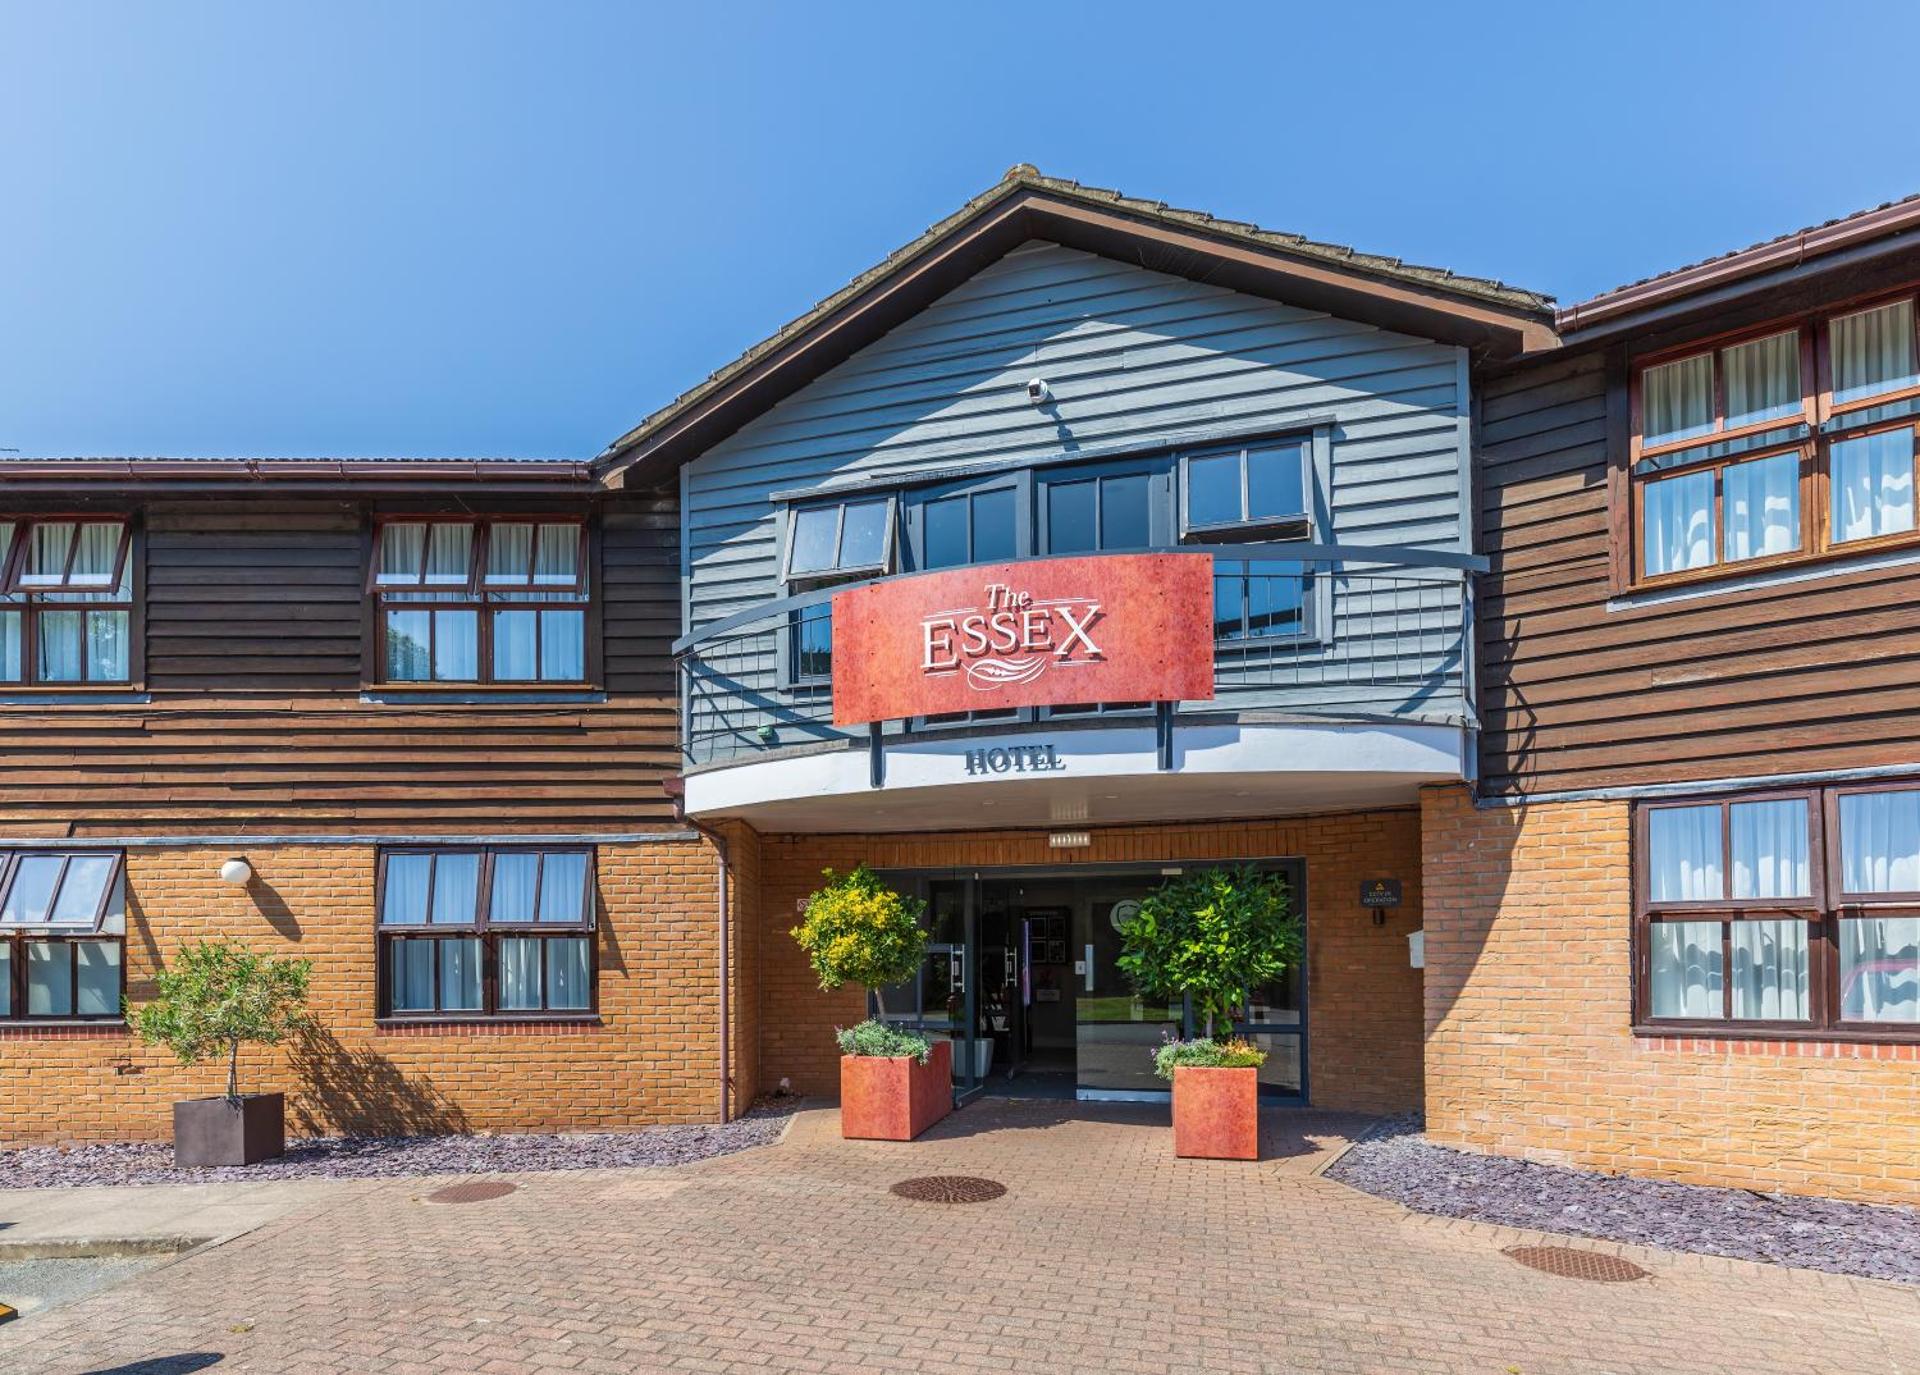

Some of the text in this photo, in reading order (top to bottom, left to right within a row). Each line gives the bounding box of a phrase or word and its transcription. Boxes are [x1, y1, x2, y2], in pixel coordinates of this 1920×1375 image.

[984, 583, 1032, 612] The
[920, 604, 1104, 671] ESSEX
[964, 745, 1067, 776] HOTEL
